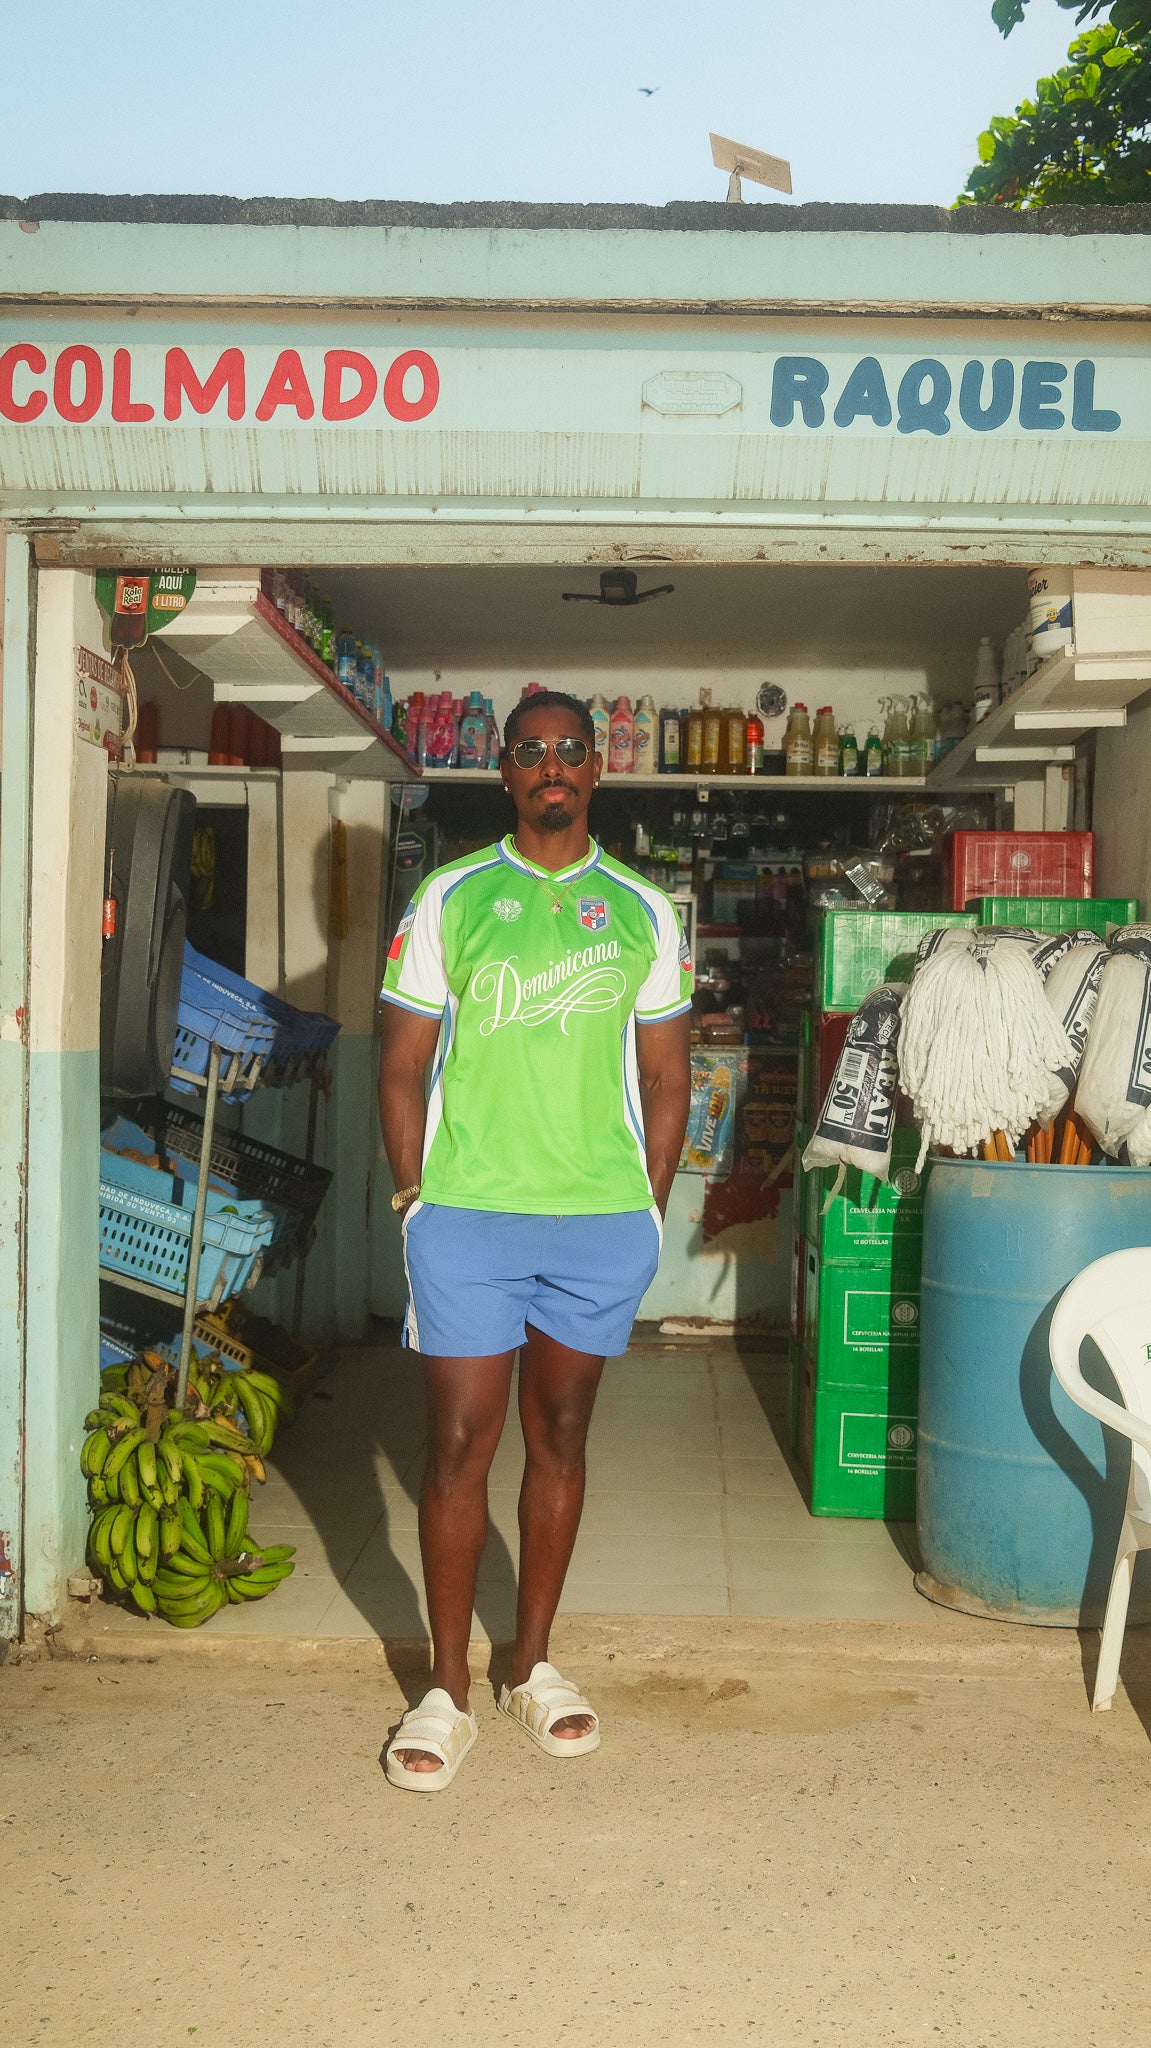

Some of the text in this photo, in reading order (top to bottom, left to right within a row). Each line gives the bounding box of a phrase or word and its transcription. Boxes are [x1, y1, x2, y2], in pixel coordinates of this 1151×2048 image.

[0, 343, 440, 423] COLMADO
[770, 356, 1121, 435] RAQUEL
[124, 587, 142, 597] Kola
[159, 575, 183, 590] AQUÍ
[123, 596, 141, 605] Real
[155, 596, 184, 608] 1 LITRO
[212, 982, 245, 1005] INDUVECA,
[471, 939, 626, 1037] Dominicana
[833, 1081, 860, 1123] 50 XL
[863, 1048, 898, 1131] REAL
[695, 1115, 718, 1151] VIVE
[100, 1184, 116, 1194] DAD
[118, 1191, 129, 1200] DE
[131, 1196, 172, 1217] INDUVECA,
[127, 1201, 138, 1209] SU
[140, 1205, 165, 1219] VENTA
